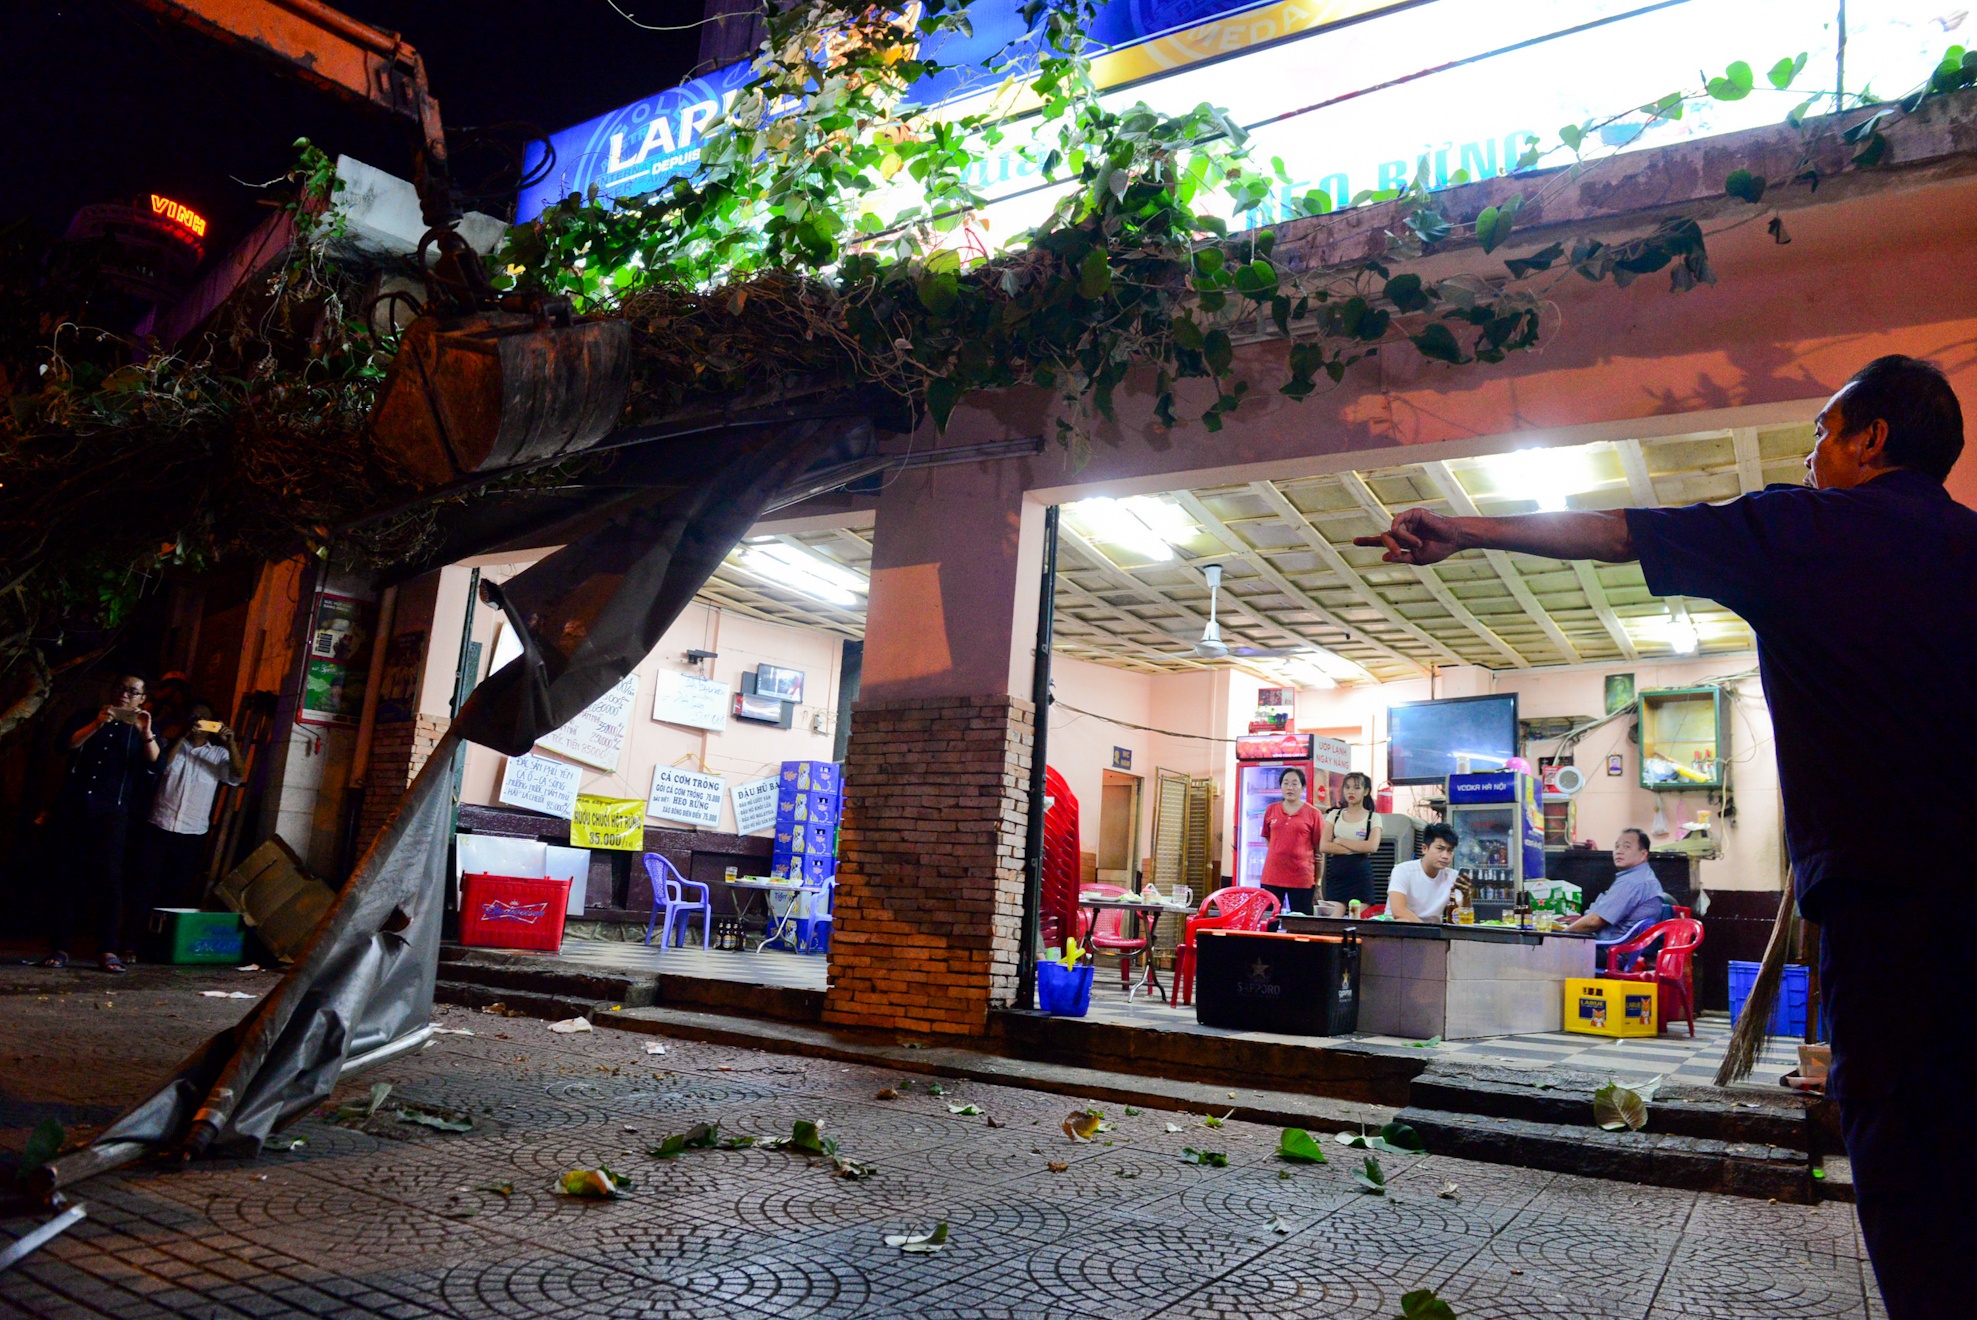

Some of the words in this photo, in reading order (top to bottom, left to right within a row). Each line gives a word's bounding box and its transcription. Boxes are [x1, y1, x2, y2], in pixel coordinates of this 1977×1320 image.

[151, 194, 206, 237] VINH
[661, 770, 672, 782] CÁ
[674, 774, 691, 786] CƠM
[666, 785, 673, 793] CÁ
[674, 787, 686, 797] CƠM
[1456, 783, 1480, 792] VODKA
[1481, 782, 1492, 791] HÀ
[1493, 781, 1507, 791] NỘI
[737, 787, 755, 800] ĐẬU
[672, 796, 687, 806] HEO
[1580, 999, 1604, 1007] LARUE
